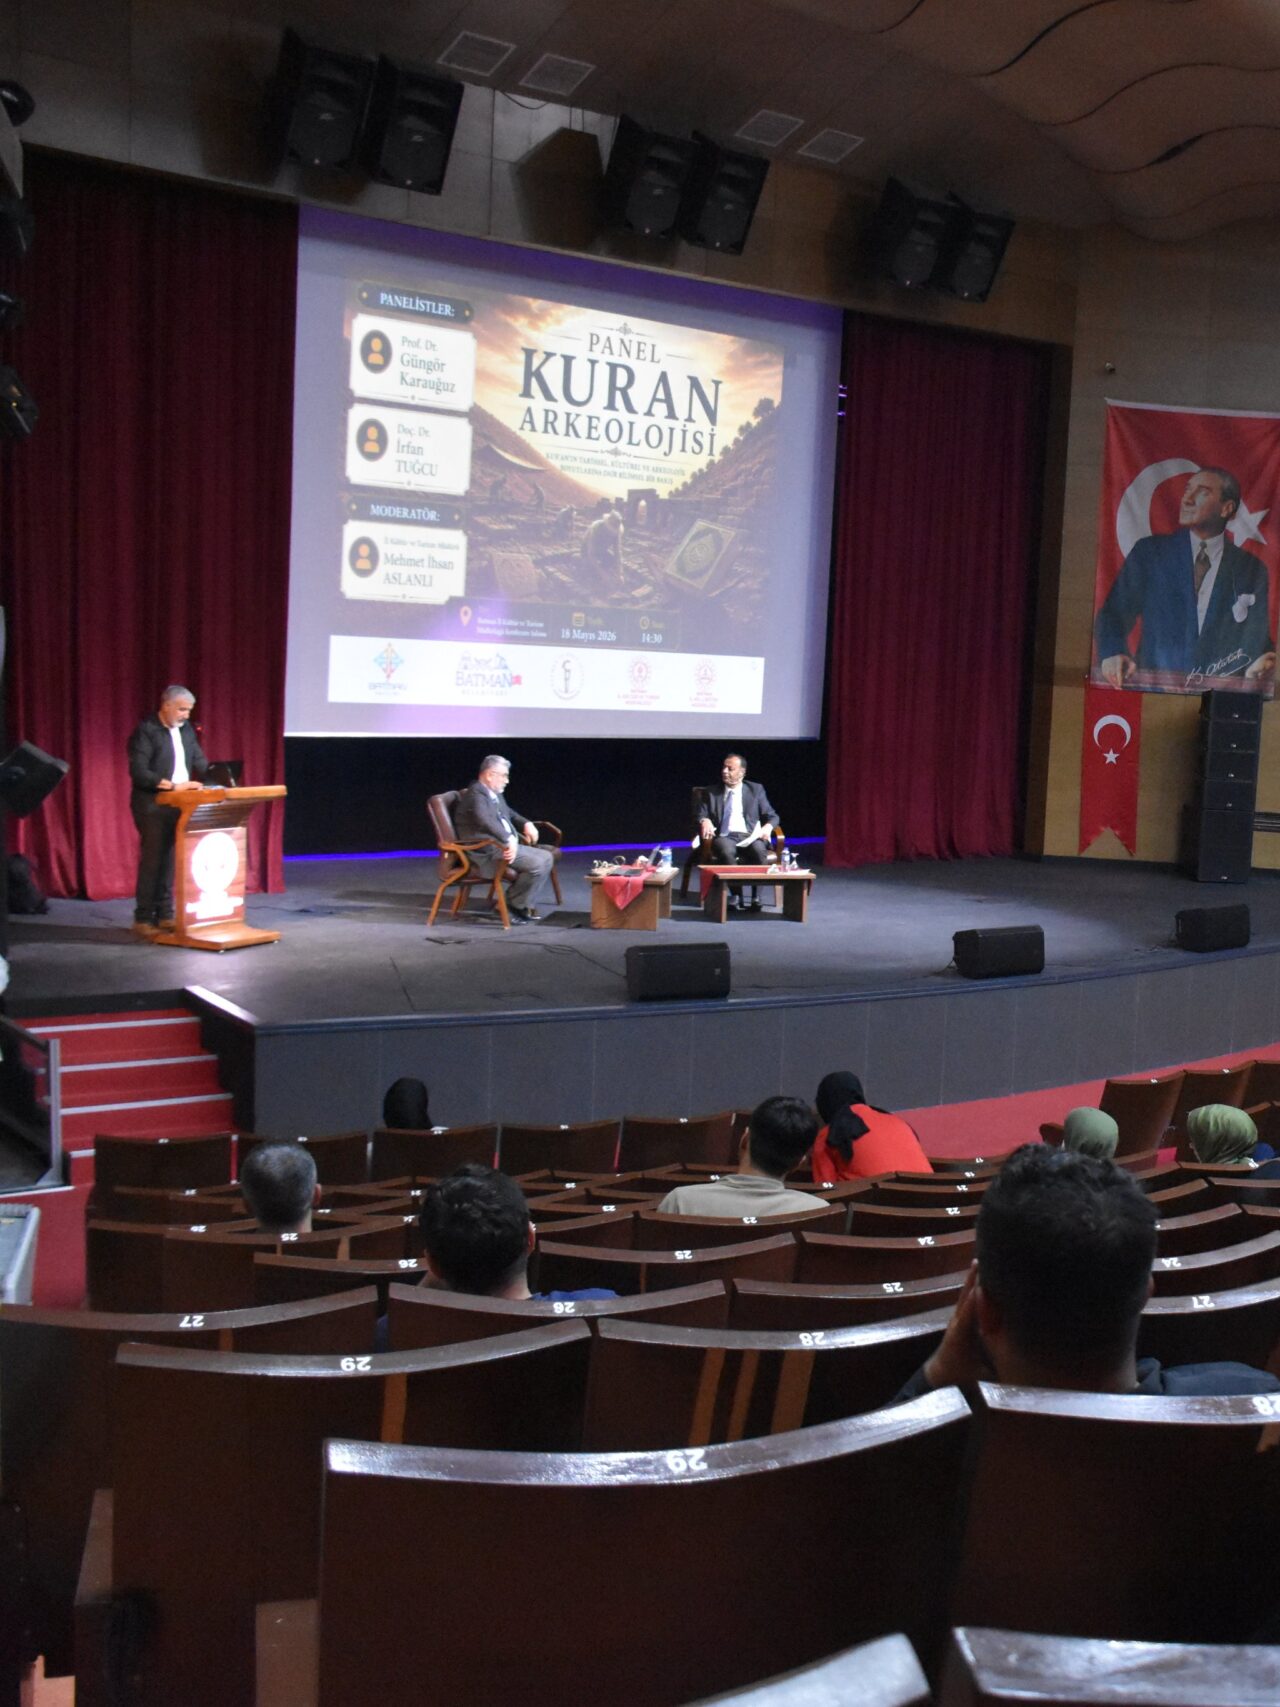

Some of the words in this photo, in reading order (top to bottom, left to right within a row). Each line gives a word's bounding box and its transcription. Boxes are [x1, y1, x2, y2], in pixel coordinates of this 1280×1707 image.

[380, 291, 455, 317] PANELİSTLER:
[588, 332, 661, 364] PANEL
[400, 352, 446, 375] Güngör
[399, 371, 456, 395] Karauğuz
[518, 346, 723, 427] KURAN
[519, 405, 717, 457] ARKEOLOJİSİ
[396, 437, 424, 456] İrfan
[395, 459, 438, 477] TUĞCU
[370, 504, 441, 522] MODERATÖR:
[383, 552, 425, 569] Mehmet
[427, 552, 455, 571] İhsan
[382, 572, 434, 588] ASLANLI
[597, 630, 617, 642] 2026
[641, 632, 663, 644] 14:30
[456, 671, 513, 688] BATMAN
[945, 1206, 961, 1216] 22
[742, 1216, 758, 1224] 23
[281, 1232, 298, 1242] 25
[917, 1236, 935, 1246] 24
[674, 1250, 693, 1260] 25
[1161, 1257, 1182, 1269] 24
[398, 1258, 418, 1269] 26
[882, 1282, 904, 1293] 25
[553, 1301, 576, 1315] 26
[1191, 1295, 1216, 1310] 27
[179, 1314, 204, 1328] 27
[799, 1331, 826, 1347] 28
[340, 1355, 372, 1373] 29
[666, 1448, 708, 1474] 29
